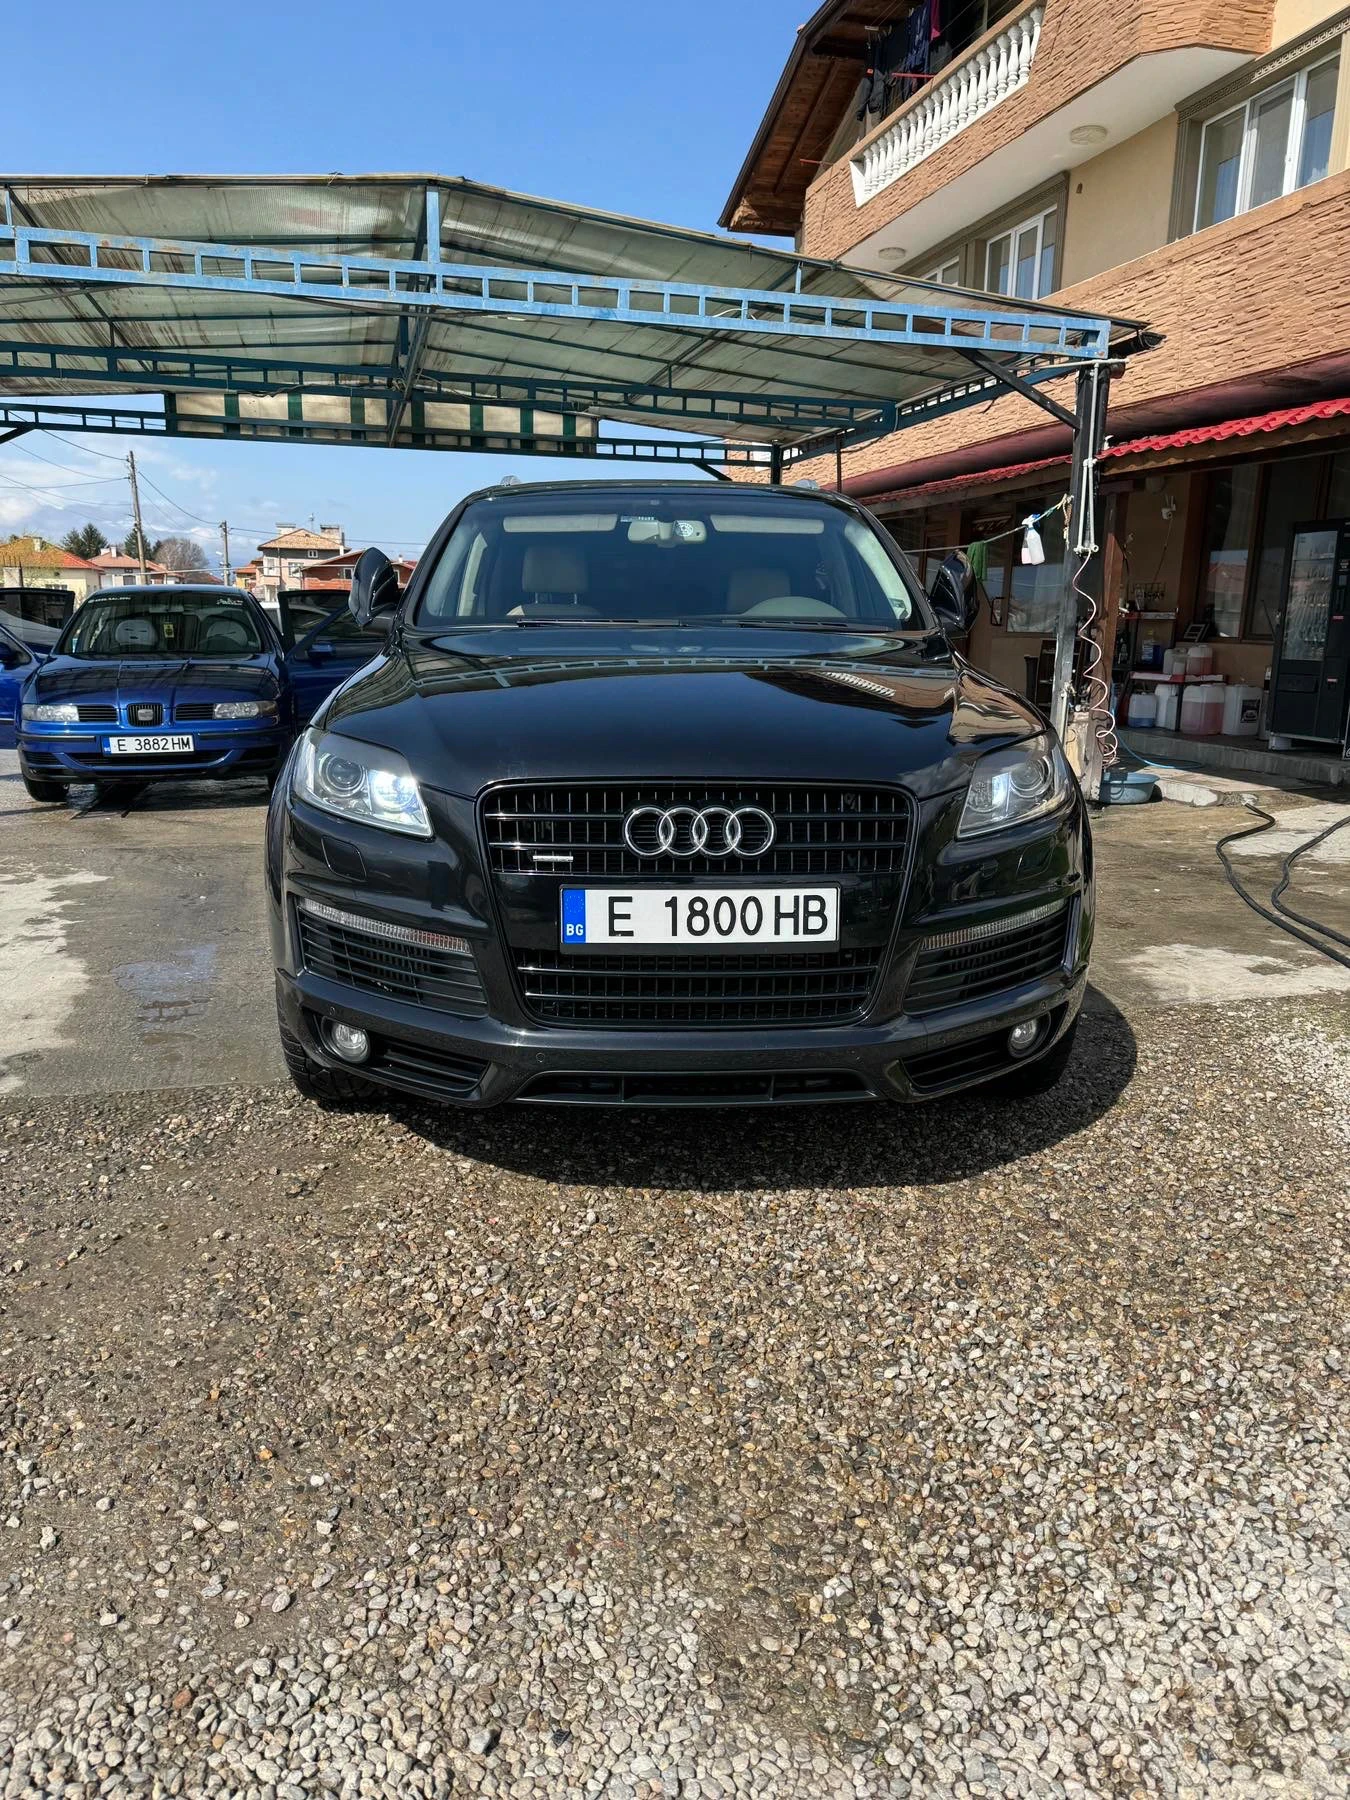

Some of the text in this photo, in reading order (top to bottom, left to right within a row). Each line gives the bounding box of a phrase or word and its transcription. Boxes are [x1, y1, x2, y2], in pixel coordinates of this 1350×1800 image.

[117, 737, 191, 751] E 3882 HM
[608, 894, 828, 937] E 1800 HB
[566, 923, 584, 936] BG
